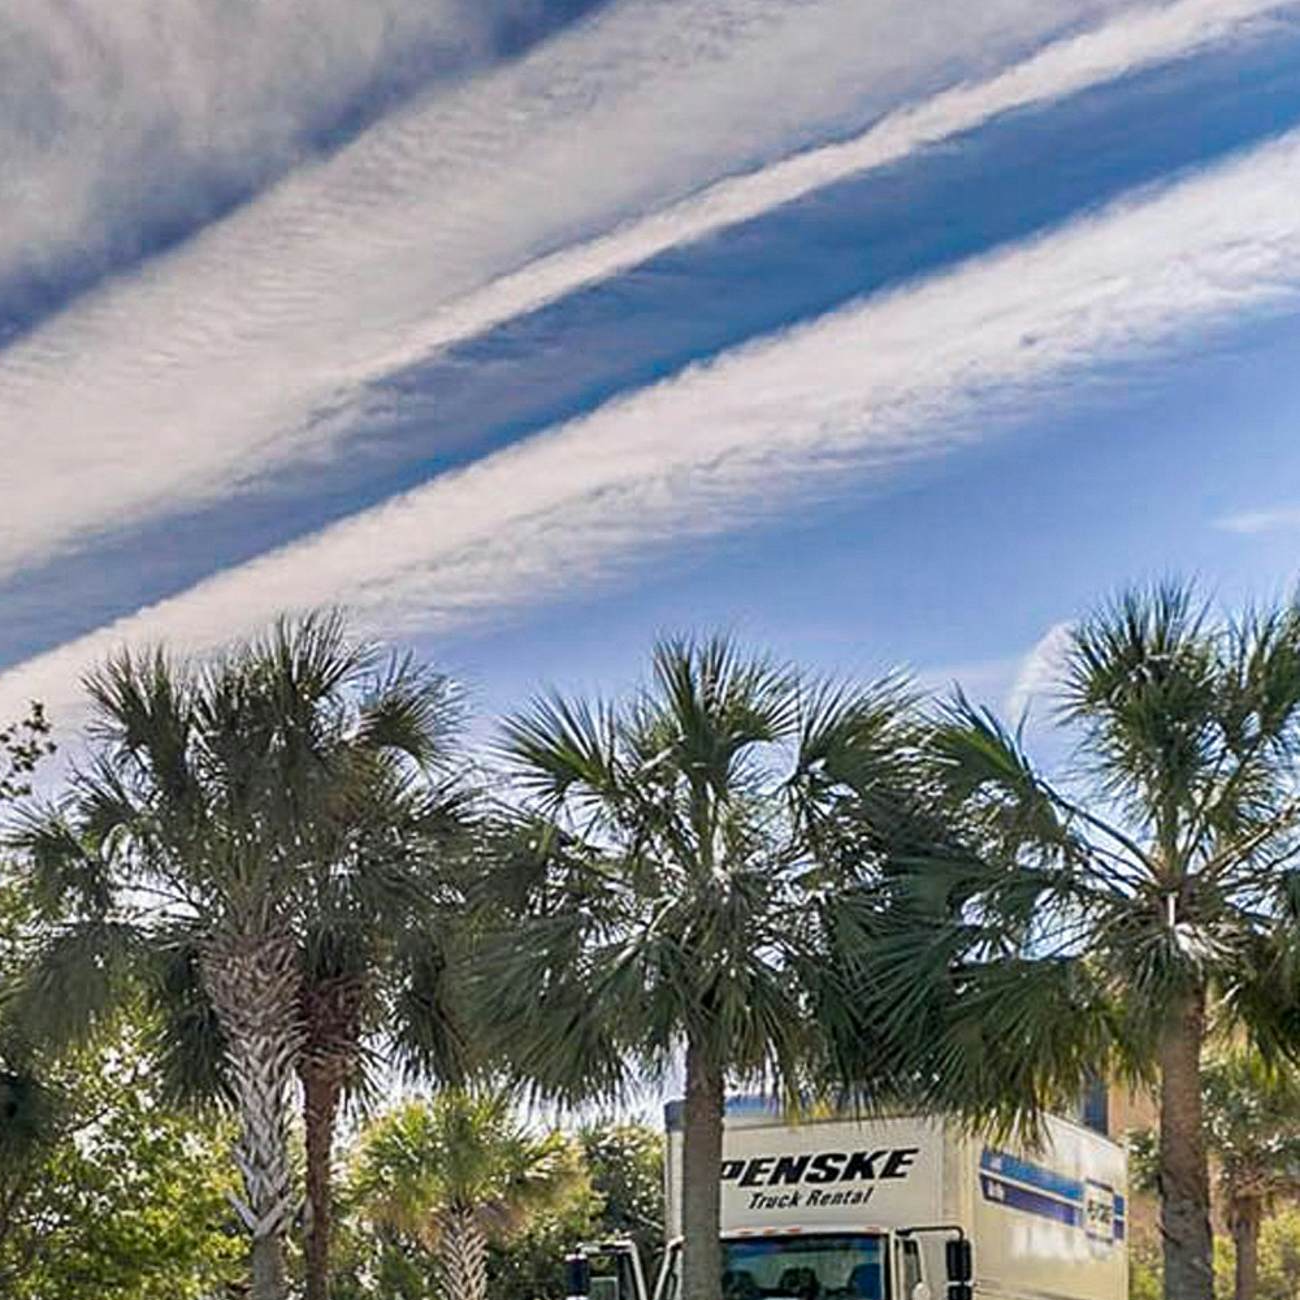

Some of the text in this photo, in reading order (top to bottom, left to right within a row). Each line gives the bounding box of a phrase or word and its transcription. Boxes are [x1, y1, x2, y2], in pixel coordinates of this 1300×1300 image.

[721, 1148, 920, 1187] PENSKE
[749, 1187, 873, 1210] Truck Rental
